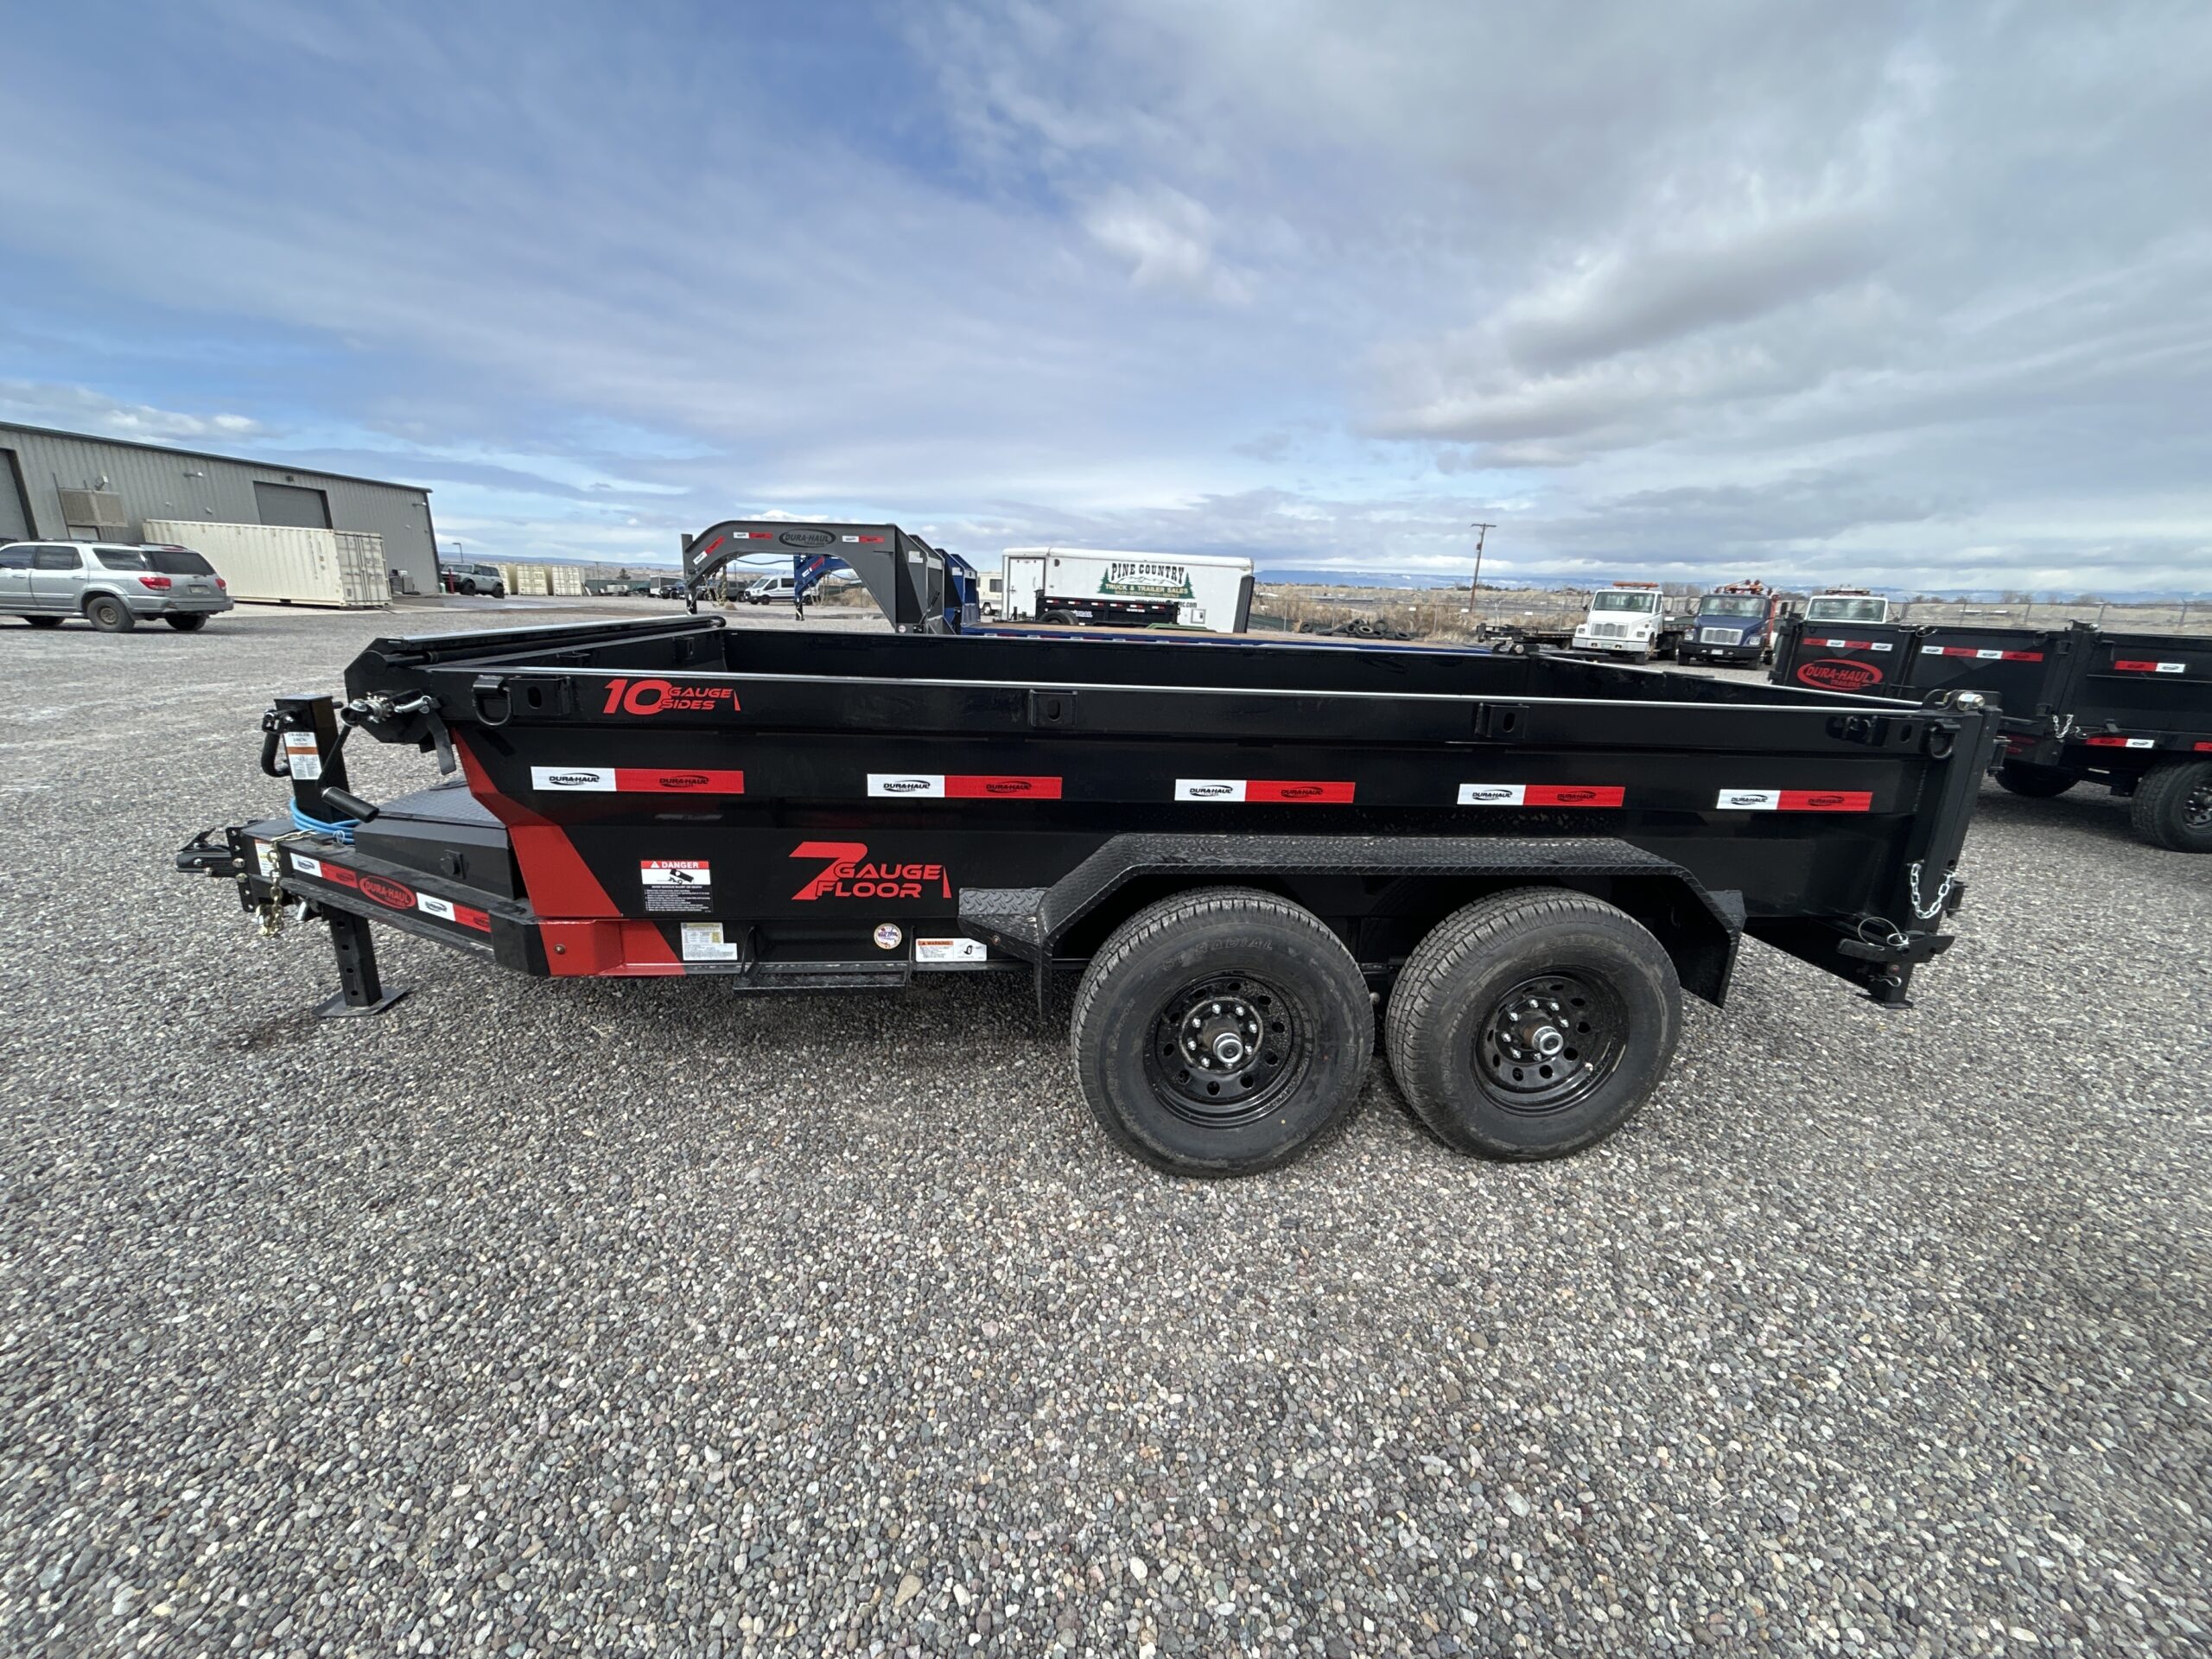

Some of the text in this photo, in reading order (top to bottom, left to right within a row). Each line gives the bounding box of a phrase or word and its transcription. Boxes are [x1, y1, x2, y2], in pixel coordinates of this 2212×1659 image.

[785, 533, 830, 542] DURA-HAUL
[1111, 563, 1185, 584] PINE COUNTRY
[1806, 665, 1871, 682] DURA-HAUL
[603, 678, 672, 715] 10
[668, 687, 734, 699] GAUGE
[659, 698, 716, 710] SIDES
[788, 841, 868, 900] 7
[834, 862, 943, 880] GAUGE
[365, 880, 410, 904] DURA-HAUL
[817, 880, 923, 899] FLOOR
[1194, 936, 1274, 956] RADIAL
